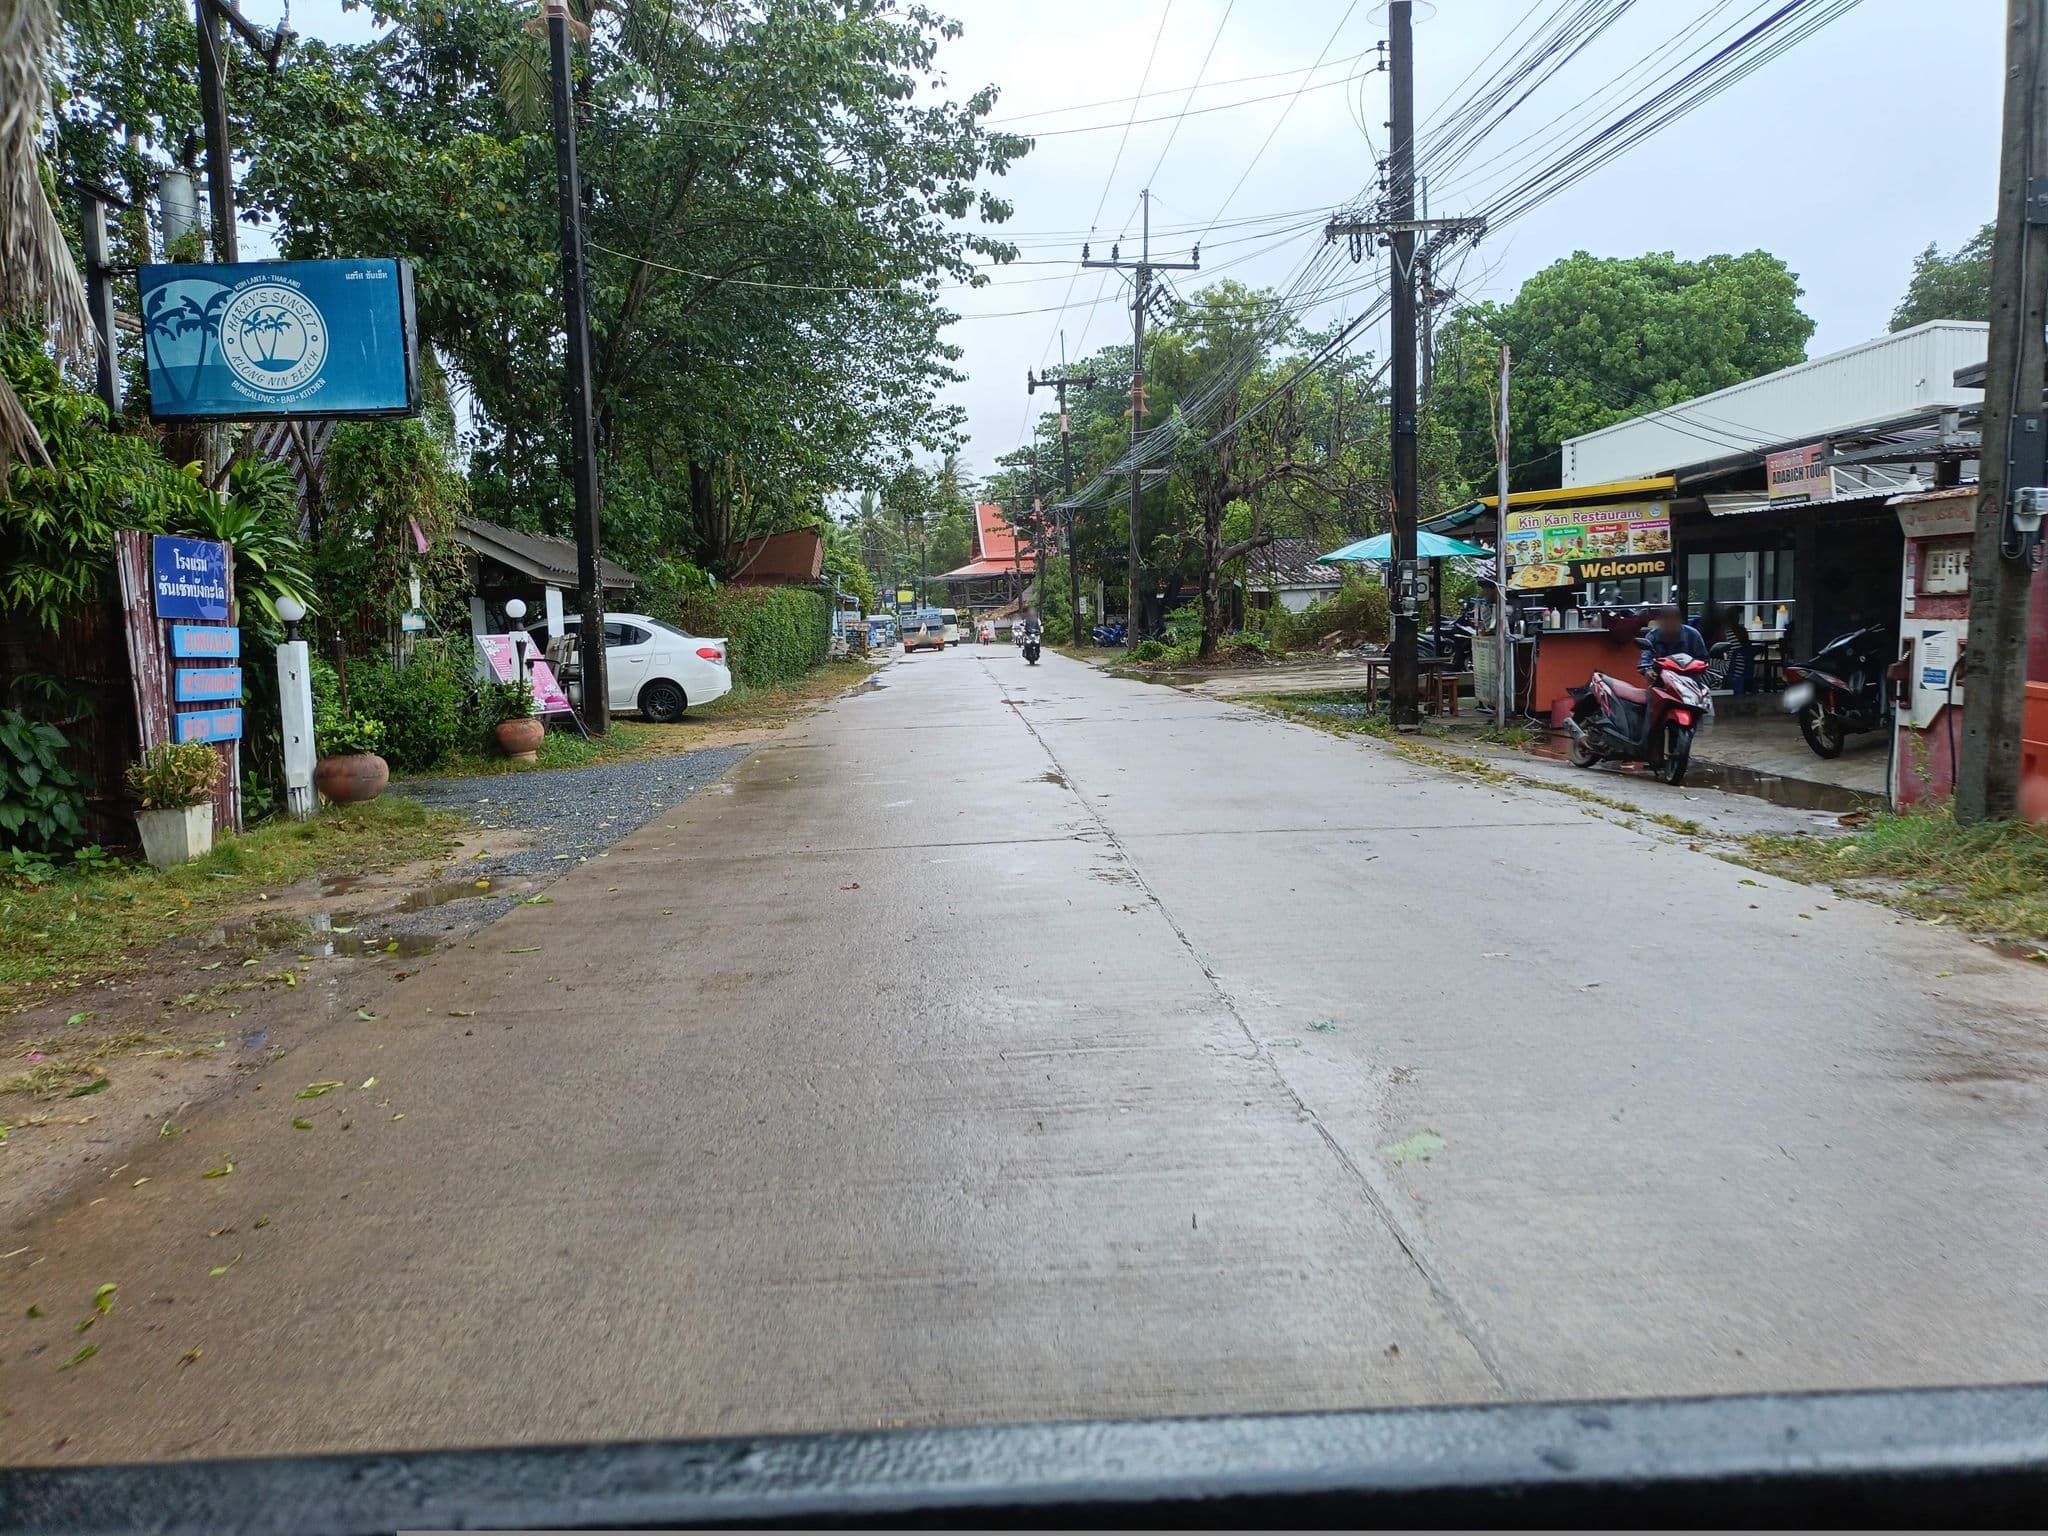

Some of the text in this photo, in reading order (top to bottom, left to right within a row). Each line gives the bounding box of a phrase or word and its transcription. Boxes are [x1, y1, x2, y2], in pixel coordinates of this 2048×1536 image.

[247, 275, 267, 284] LANTA
[270, 274, 301, 288] THAILAND
[227, 292, 318, 332] HARRY'S SUNSET
[232, 350, 319, 386] KLONG NIN BEACH
[231, 377, 326, 404] BUNGALOWS BAR KITCHEN
[1518, 510, 1642, 529] Kin Kan Restaurant
[173, 547, 208, 572] โรงแรม
[1580, 559, 1665, 578] Welcome
